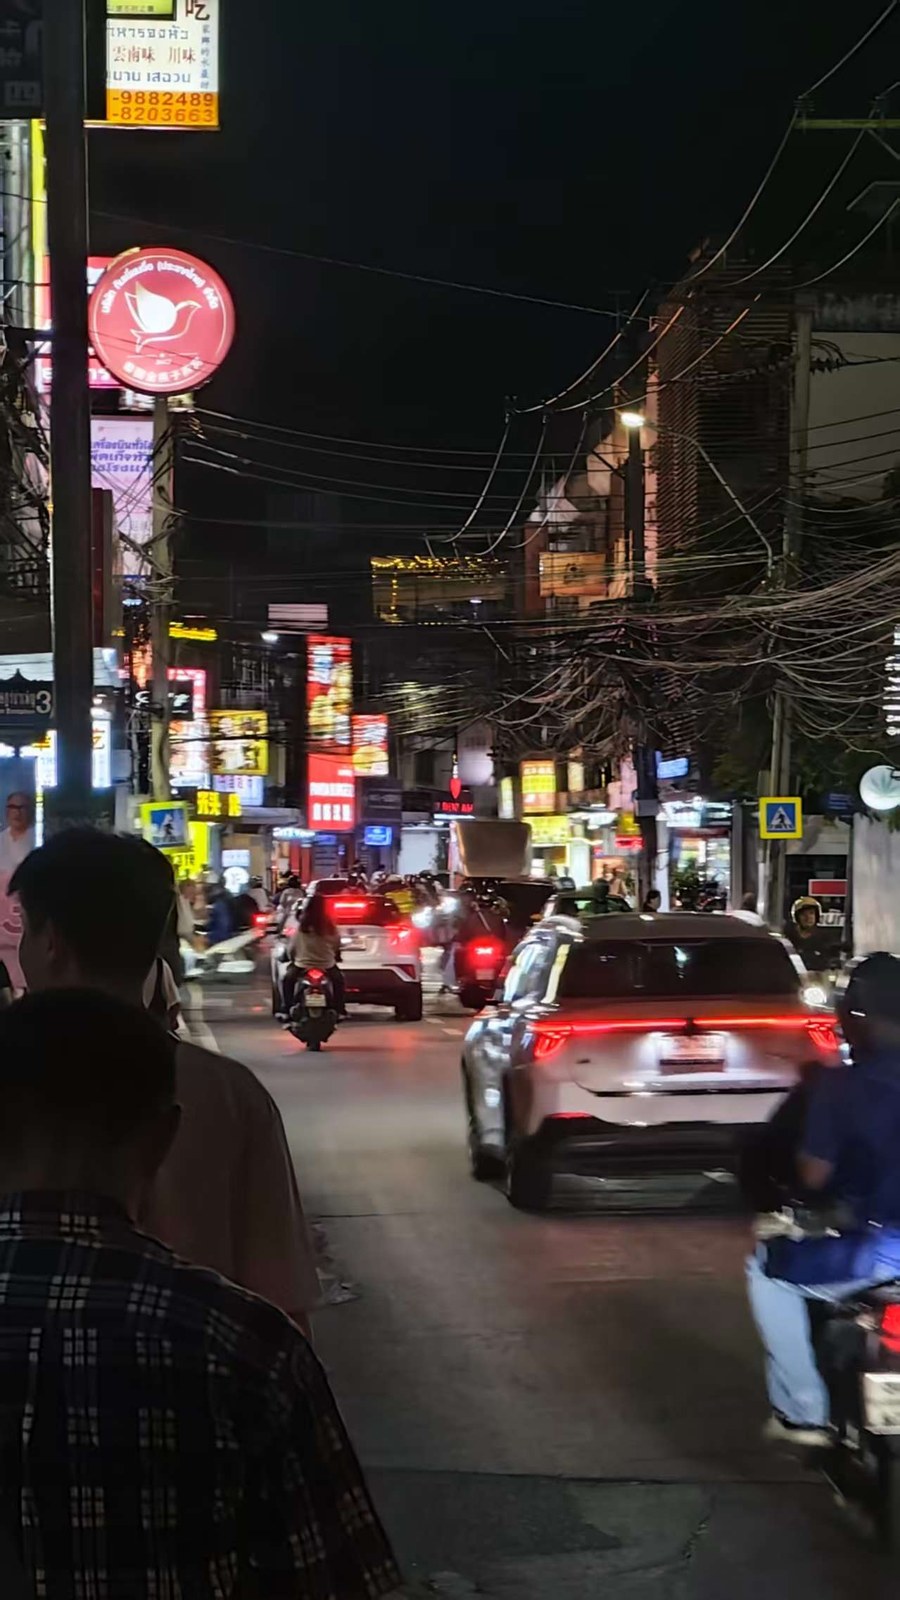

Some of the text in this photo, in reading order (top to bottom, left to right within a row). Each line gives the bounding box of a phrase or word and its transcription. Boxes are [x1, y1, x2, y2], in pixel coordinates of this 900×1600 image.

[169, 46, 196, 64] 川味
[112, 90, 214, 106] -9882489
[112, 106, 214, 122] -8203663
[36, 690, 52, 714] 3
